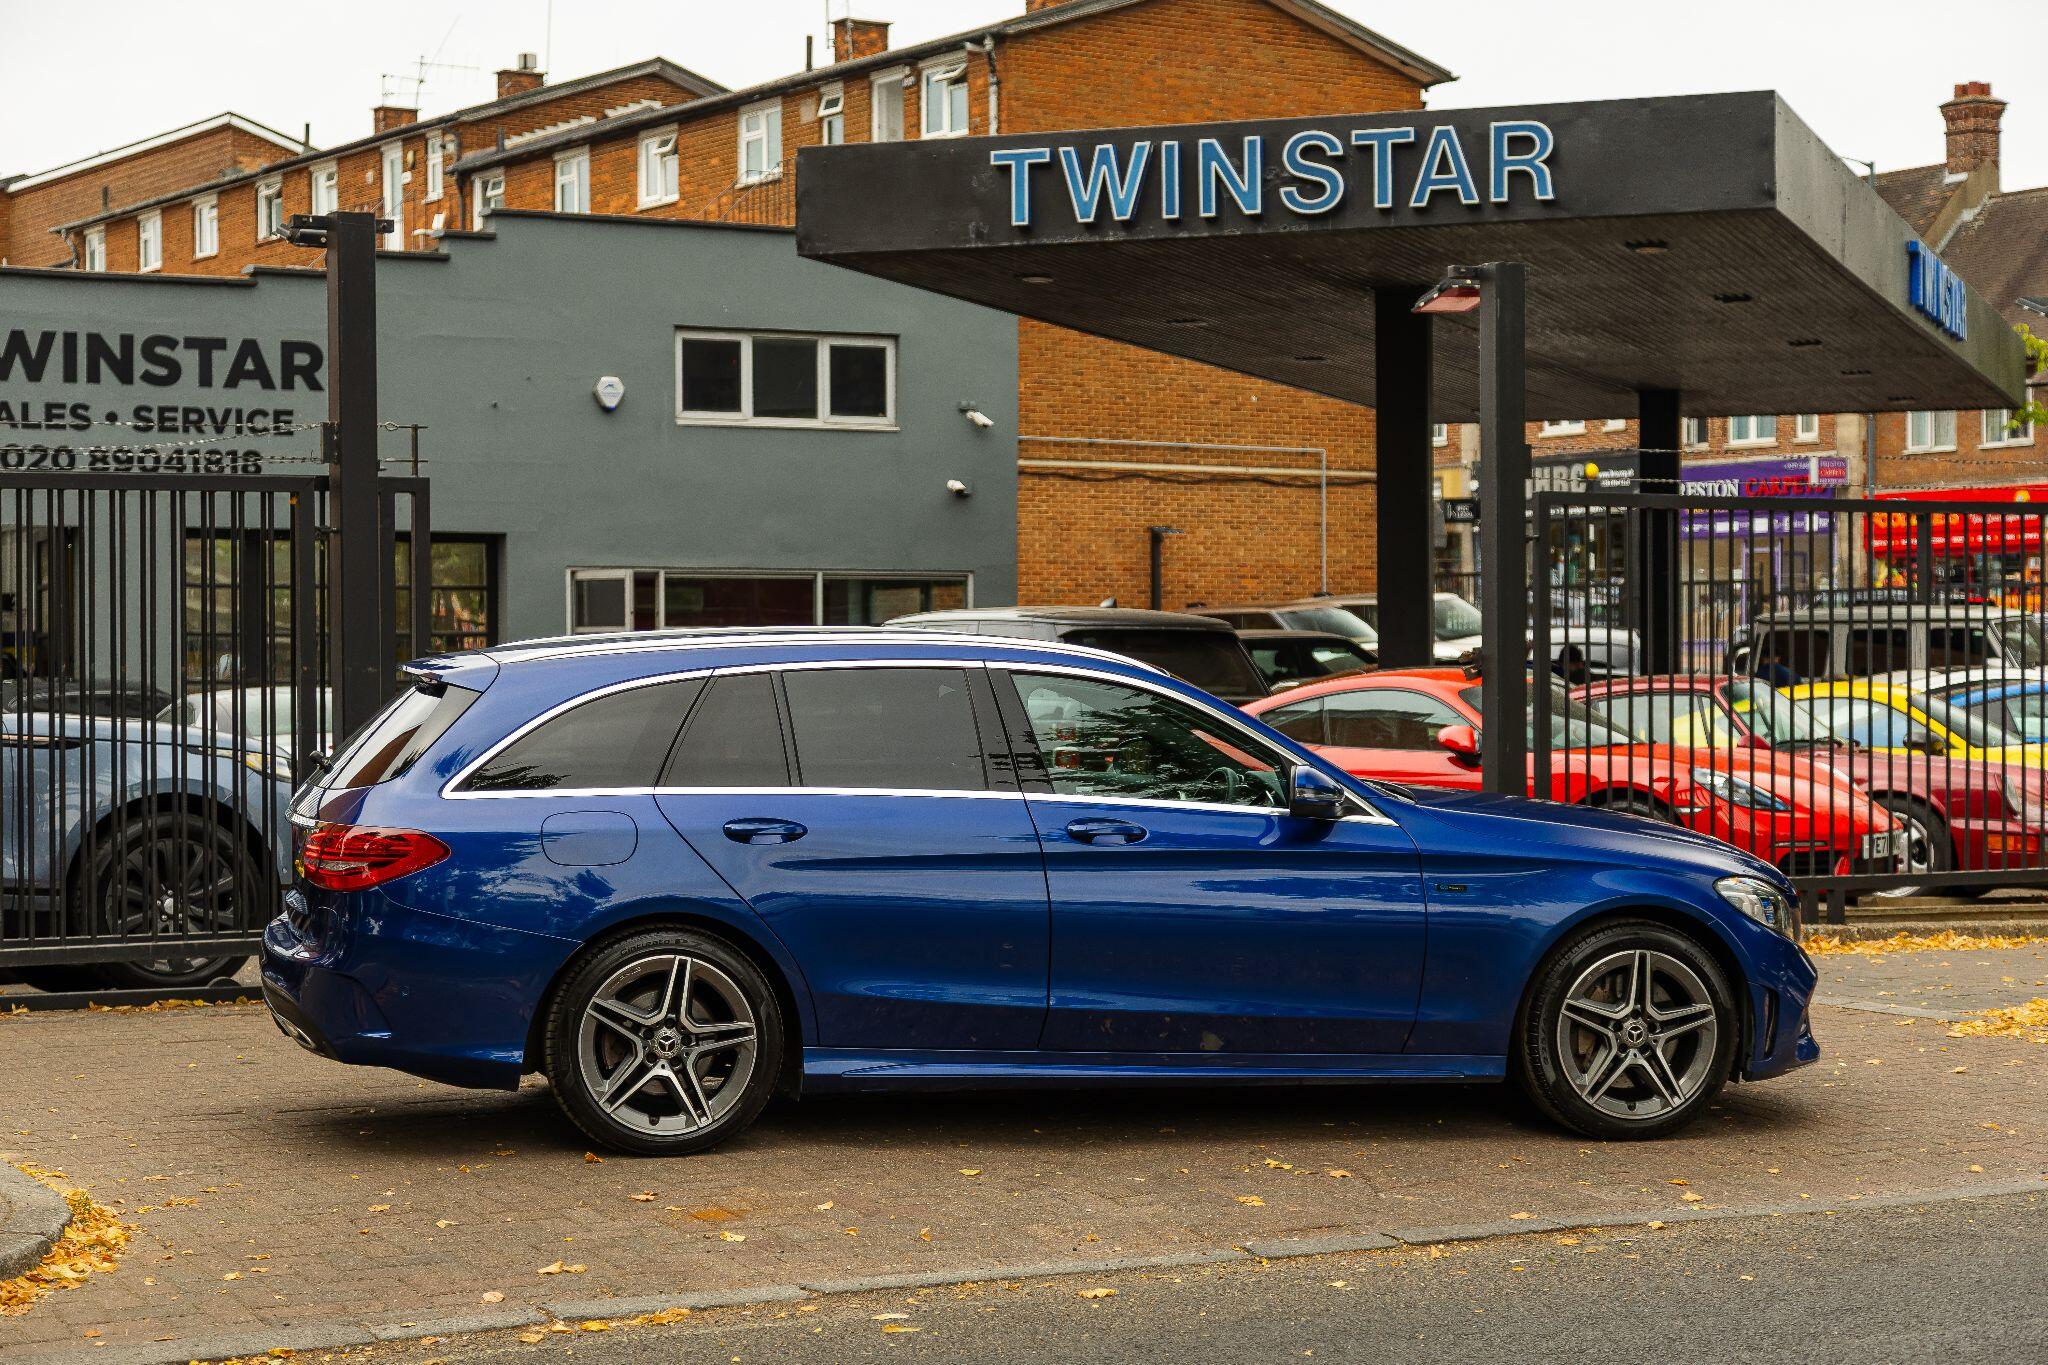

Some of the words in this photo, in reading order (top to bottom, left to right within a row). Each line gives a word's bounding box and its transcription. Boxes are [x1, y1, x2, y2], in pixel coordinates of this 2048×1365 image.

[989, 120, 1555, 227] TWINSTAR
[0, 328, 325, 391] WINSTAR
[132, 404, 295, 436] SERVICE
[0, 442, 77, 471] 020
[87, 445, 263, 475] 89041818
